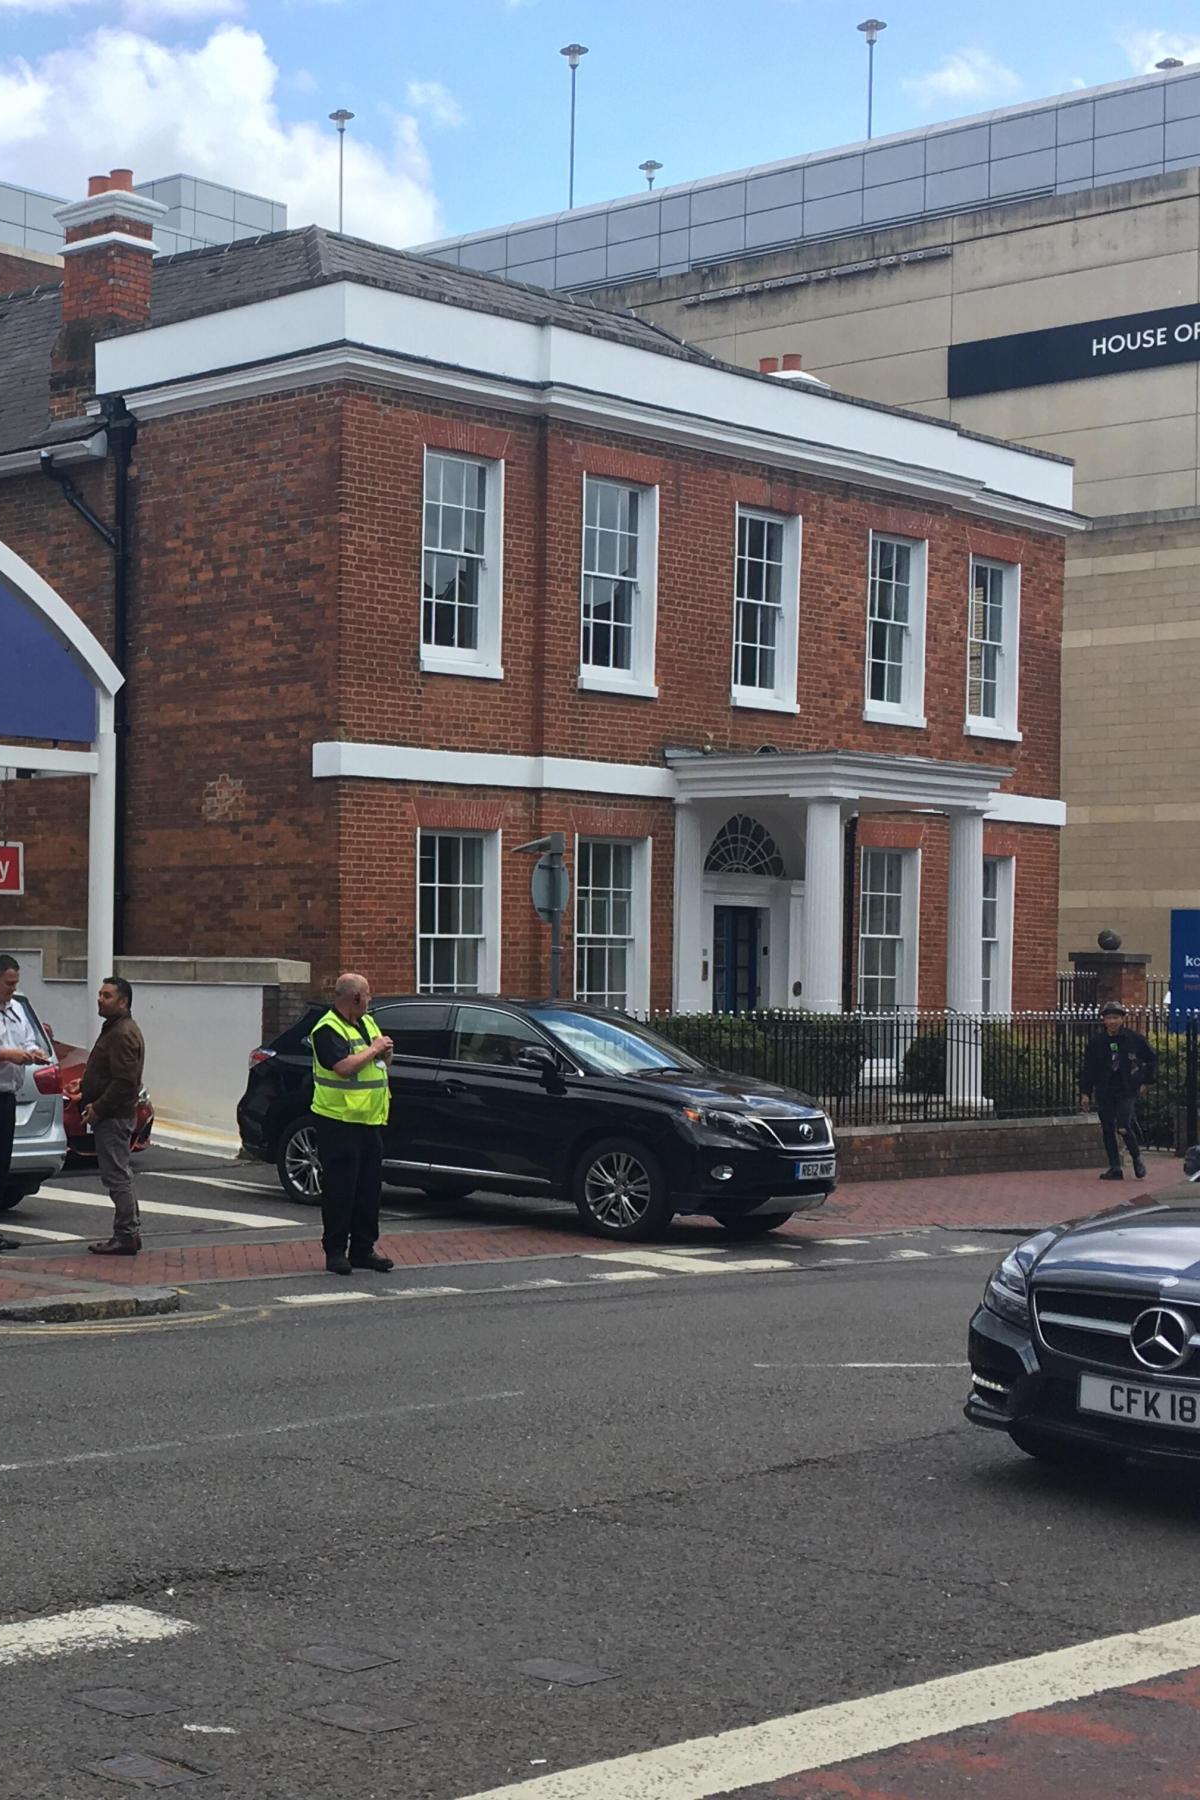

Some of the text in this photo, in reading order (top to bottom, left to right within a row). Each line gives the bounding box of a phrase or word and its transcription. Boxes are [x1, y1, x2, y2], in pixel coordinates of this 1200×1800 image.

[1092, 327, 1167, 356] HOUSE
[1110, 1384, 1197, 1424] CFK 18
